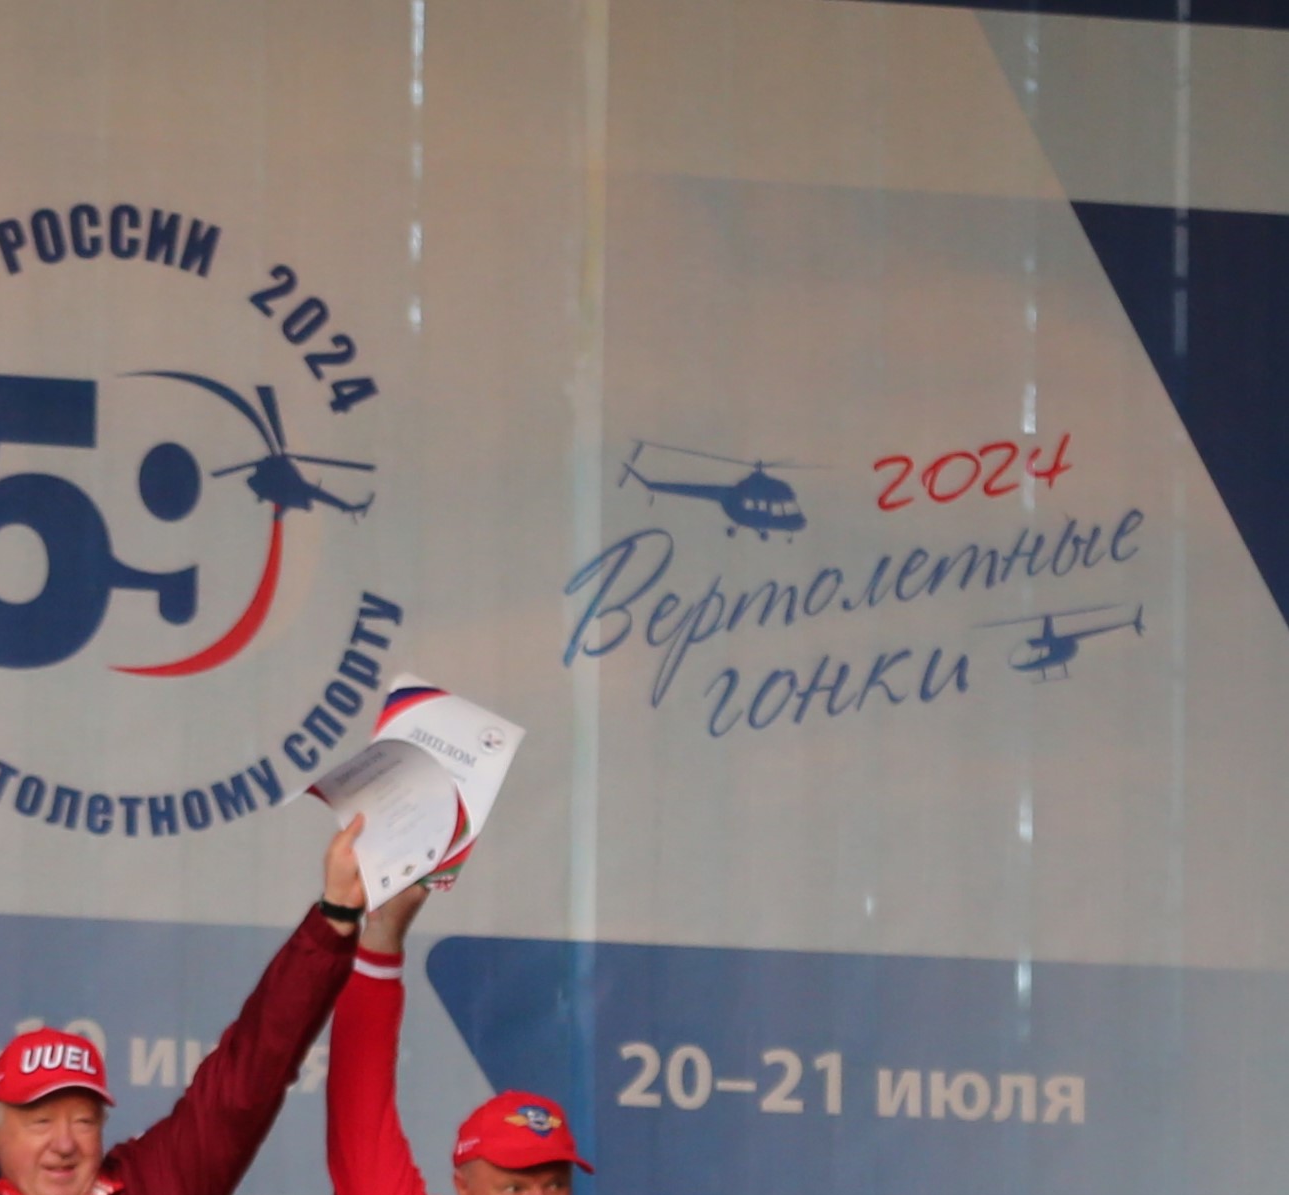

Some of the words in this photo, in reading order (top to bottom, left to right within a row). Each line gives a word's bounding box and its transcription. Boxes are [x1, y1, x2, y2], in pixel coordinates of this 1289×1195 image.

[248, 263, 380, 415] 2024
[871, 433, 1073, 512] 2024
[562, 506, 1145, 709] Вертолетные
[282, 592, 405, 774] спорту
[704, 647, 970, 738] гонки
[407, 726, 478, 769] ДИПЛОМ
[21, 1045, 98, 1075] UUEL
[617, 1041, 844, 1115] 20–21
[875, 1067, 1087, 1125] июля
